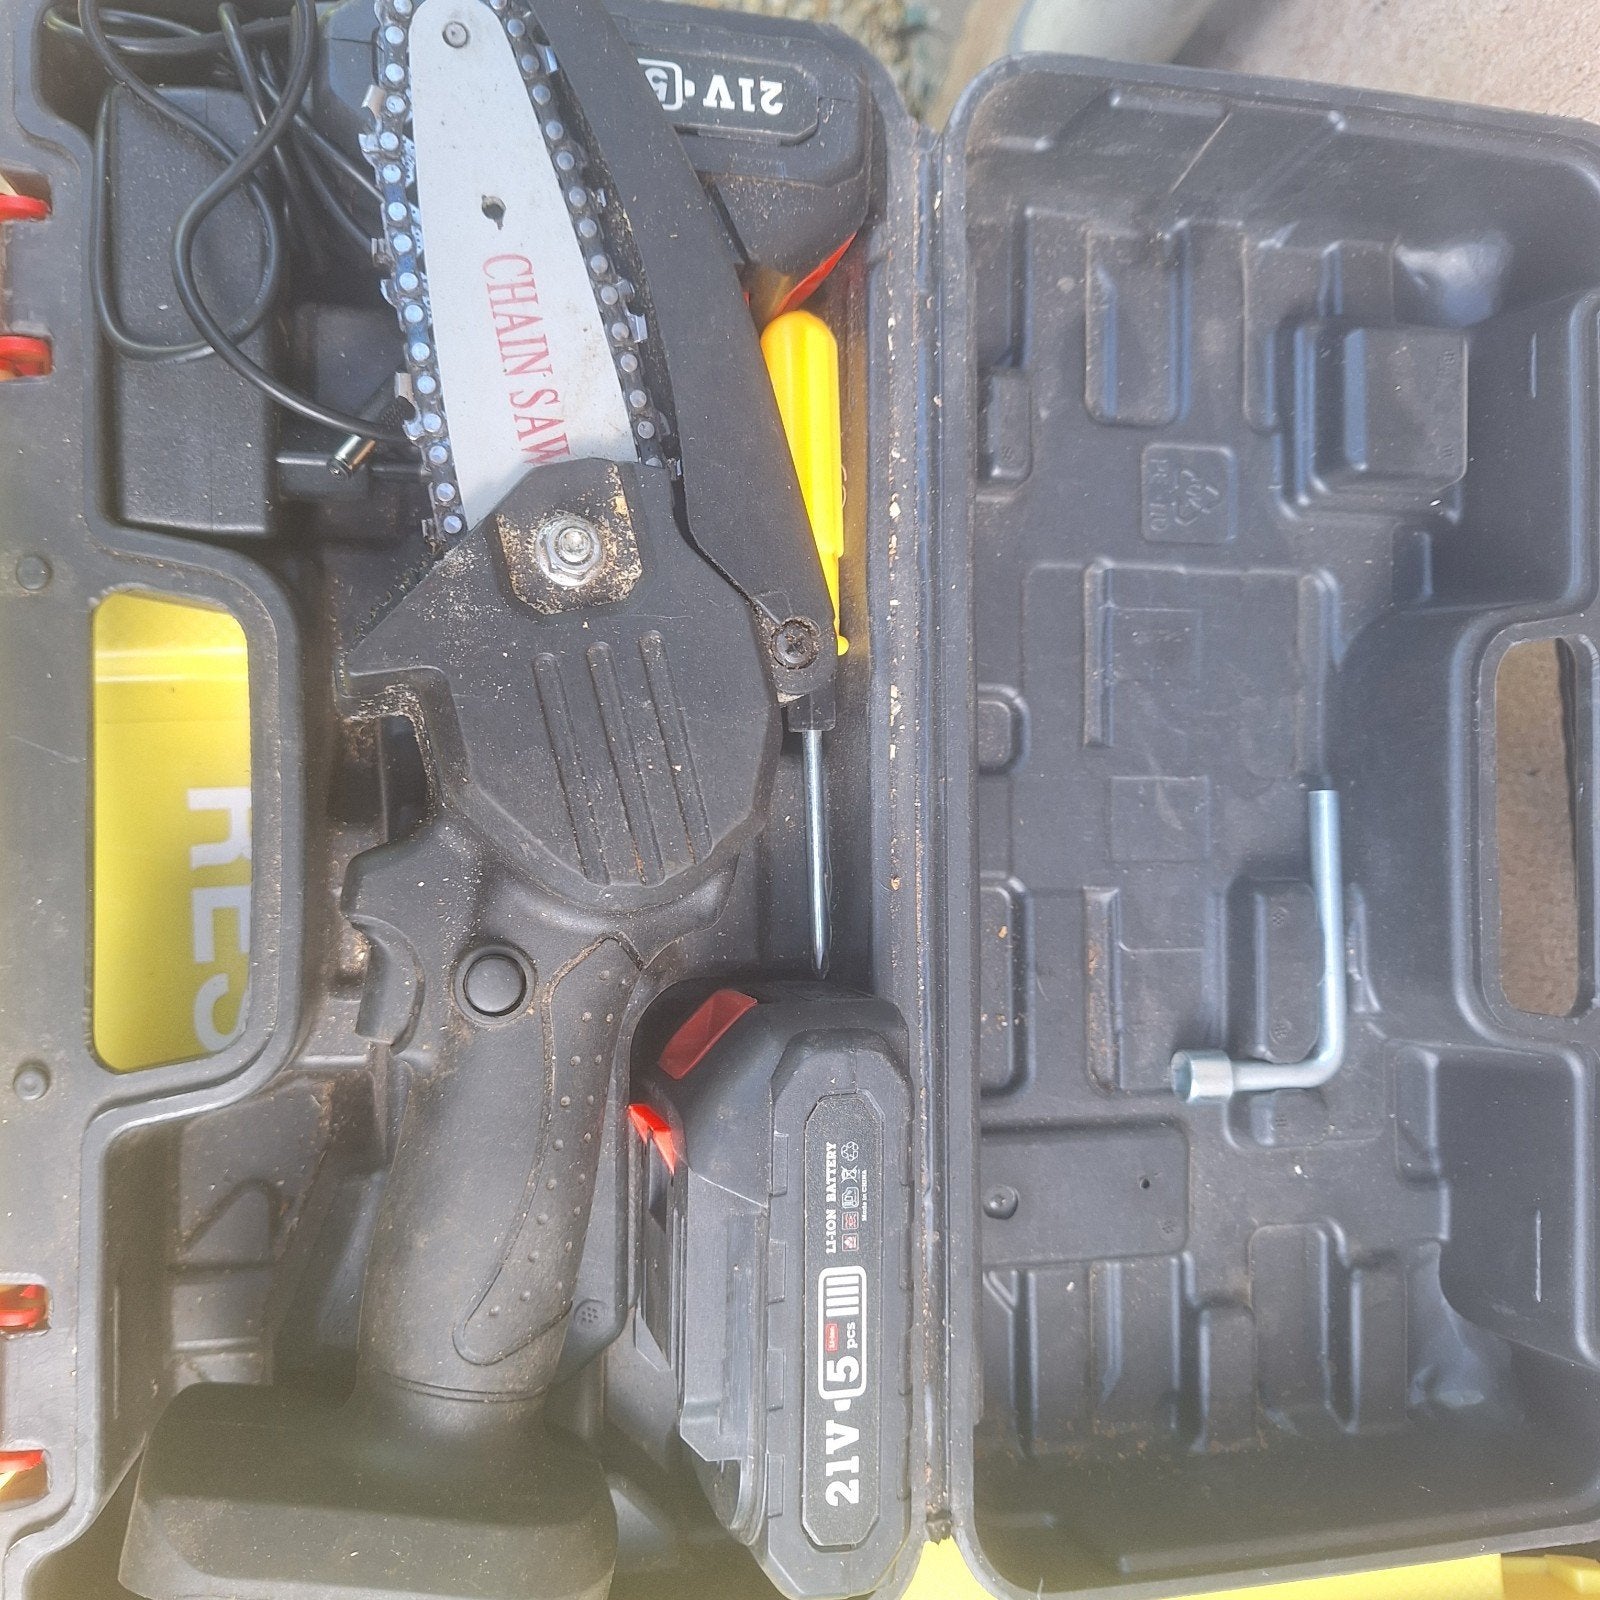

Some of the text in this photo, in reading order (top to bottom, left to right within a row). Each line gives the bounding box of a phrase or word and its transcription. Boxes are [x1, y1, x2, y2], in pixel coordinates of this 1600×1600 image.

[702, 74, 784, 116] 21V
[482, 254, 571, 465] CHAIN SAW
[825, 1141, 837, 1254] LI-ION BATTERY
[825, 1321, 860, 1507] 21V 5 pcs
